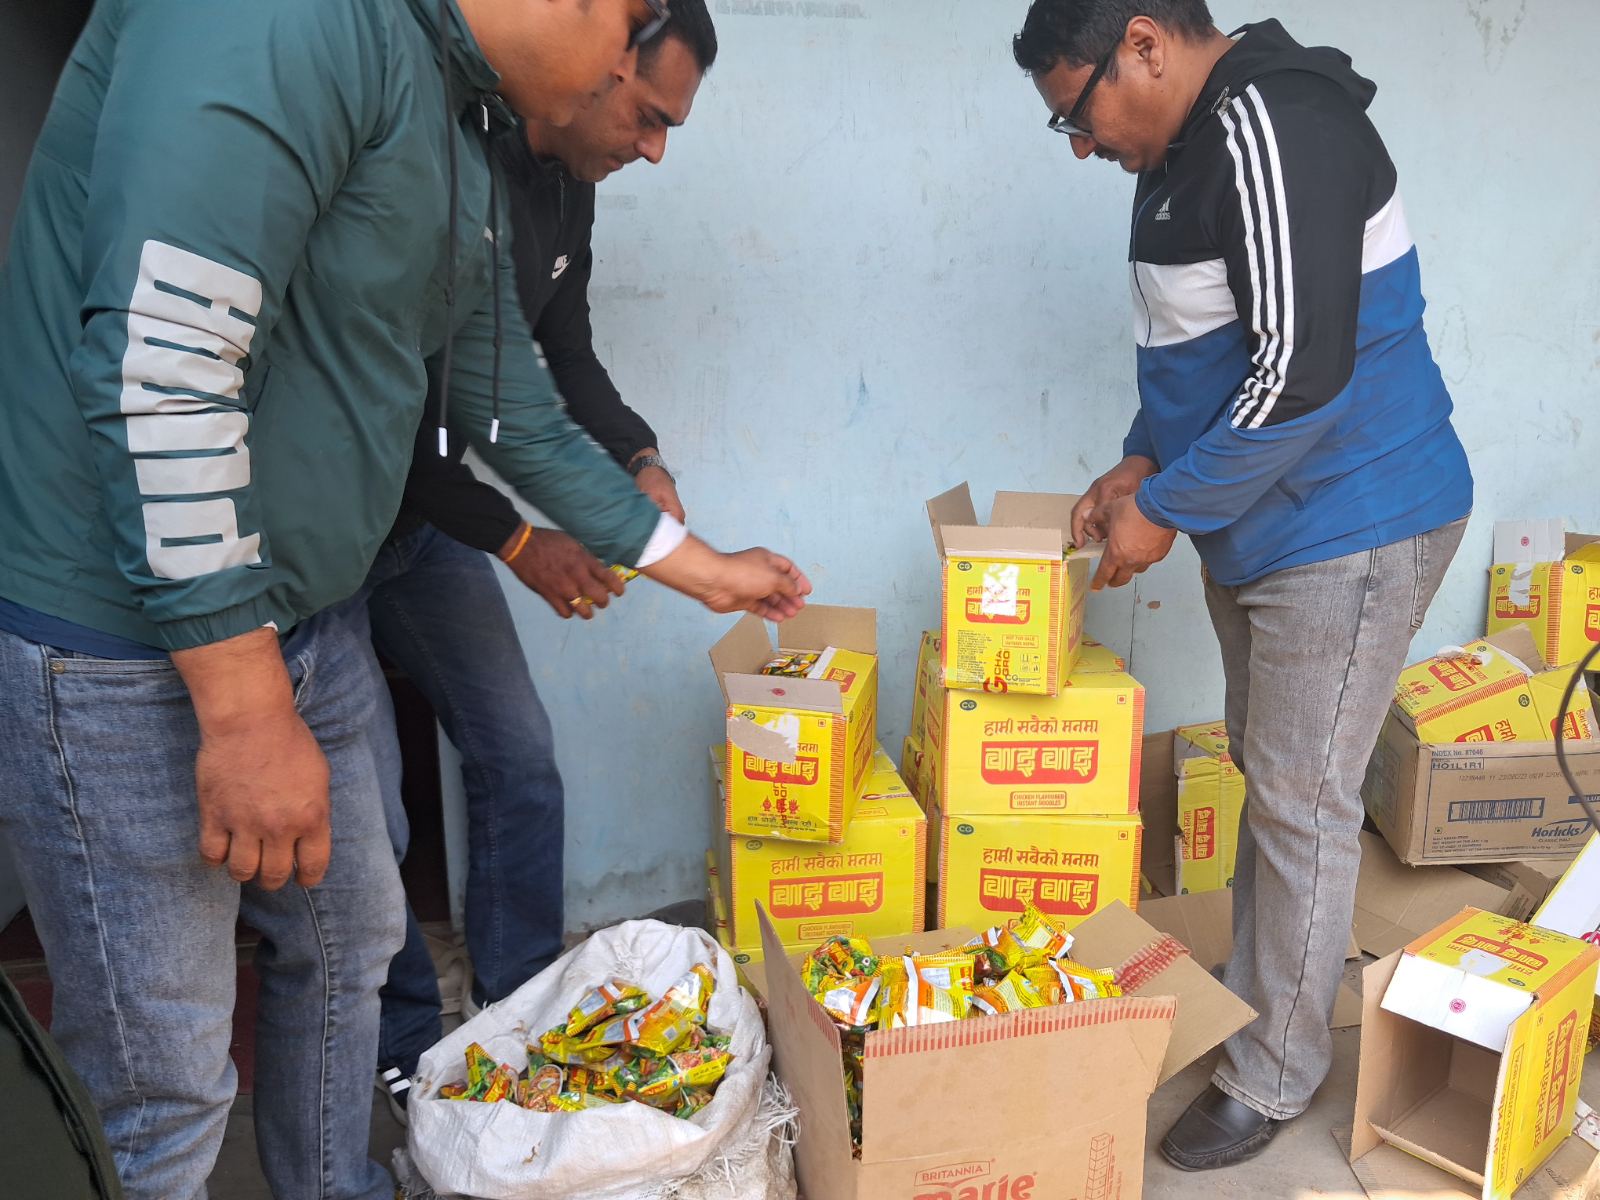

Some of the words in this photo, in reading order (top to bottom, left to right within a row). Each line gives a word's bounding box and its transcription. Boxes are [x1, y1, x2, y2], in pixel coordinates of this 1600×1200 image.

[120, 240, 262, 580] PUMA
[984, 718, 1014, 736] हामी
[1017, 715, 1058, 734] सबैको
[1062, 720, 1098, 734] मनमा
[1531, 826, 1580, 838] Horlicks
[771, 856, 800, 875] हामी
[804, 852, 843, 871] सबैको
[847, 853, 882, 867] मनमा
[983, 847, 1013, 864] हामी
[1016, 845, 1058, 866] सबैको
[1061, 852, 1099, 867] मनमा
[922, 1165, 984, 1182] BRITANNIA
